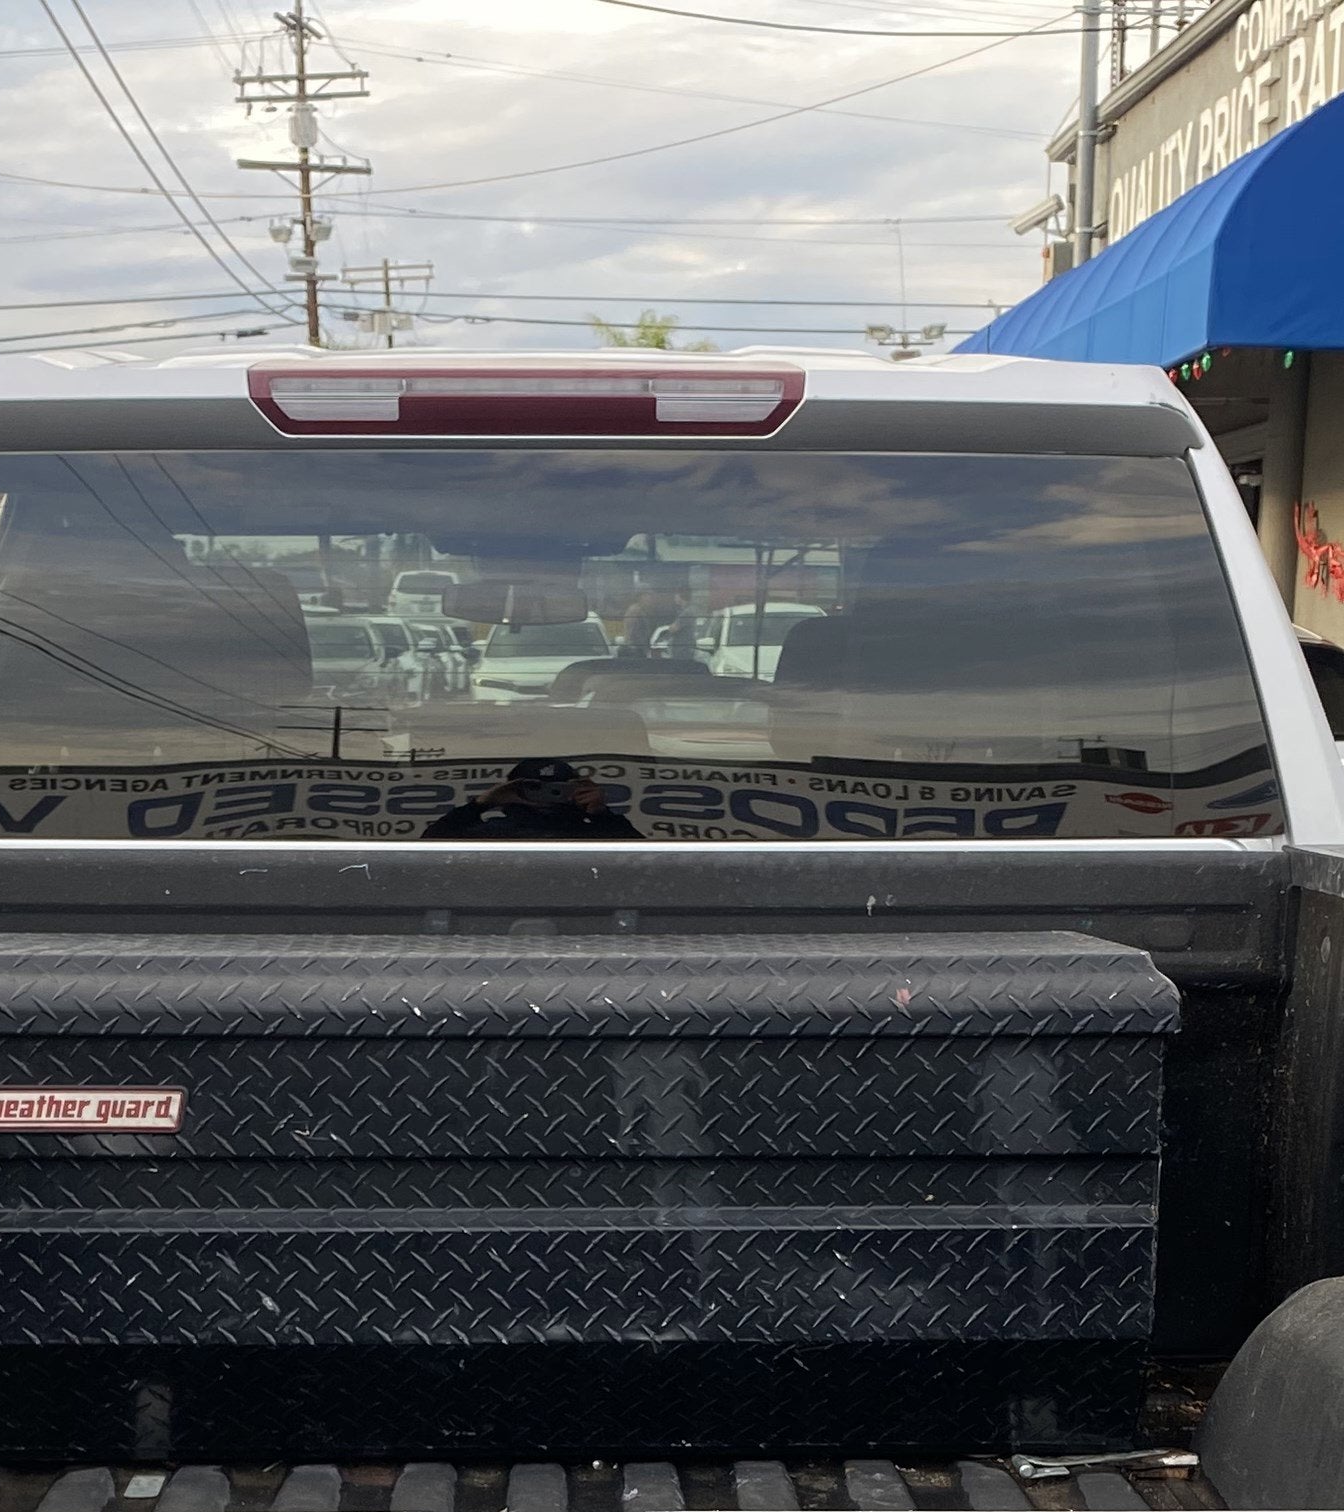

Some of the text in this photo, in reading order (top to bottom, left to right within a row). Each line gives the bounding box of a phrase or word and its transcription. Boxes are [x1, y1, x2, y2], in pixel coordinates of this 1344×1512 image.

[1109, 121, 1193, 245] QUALITY
[1197, 61, 1273, 184] PRICE
[95, 1096, 173, 1123] guard
